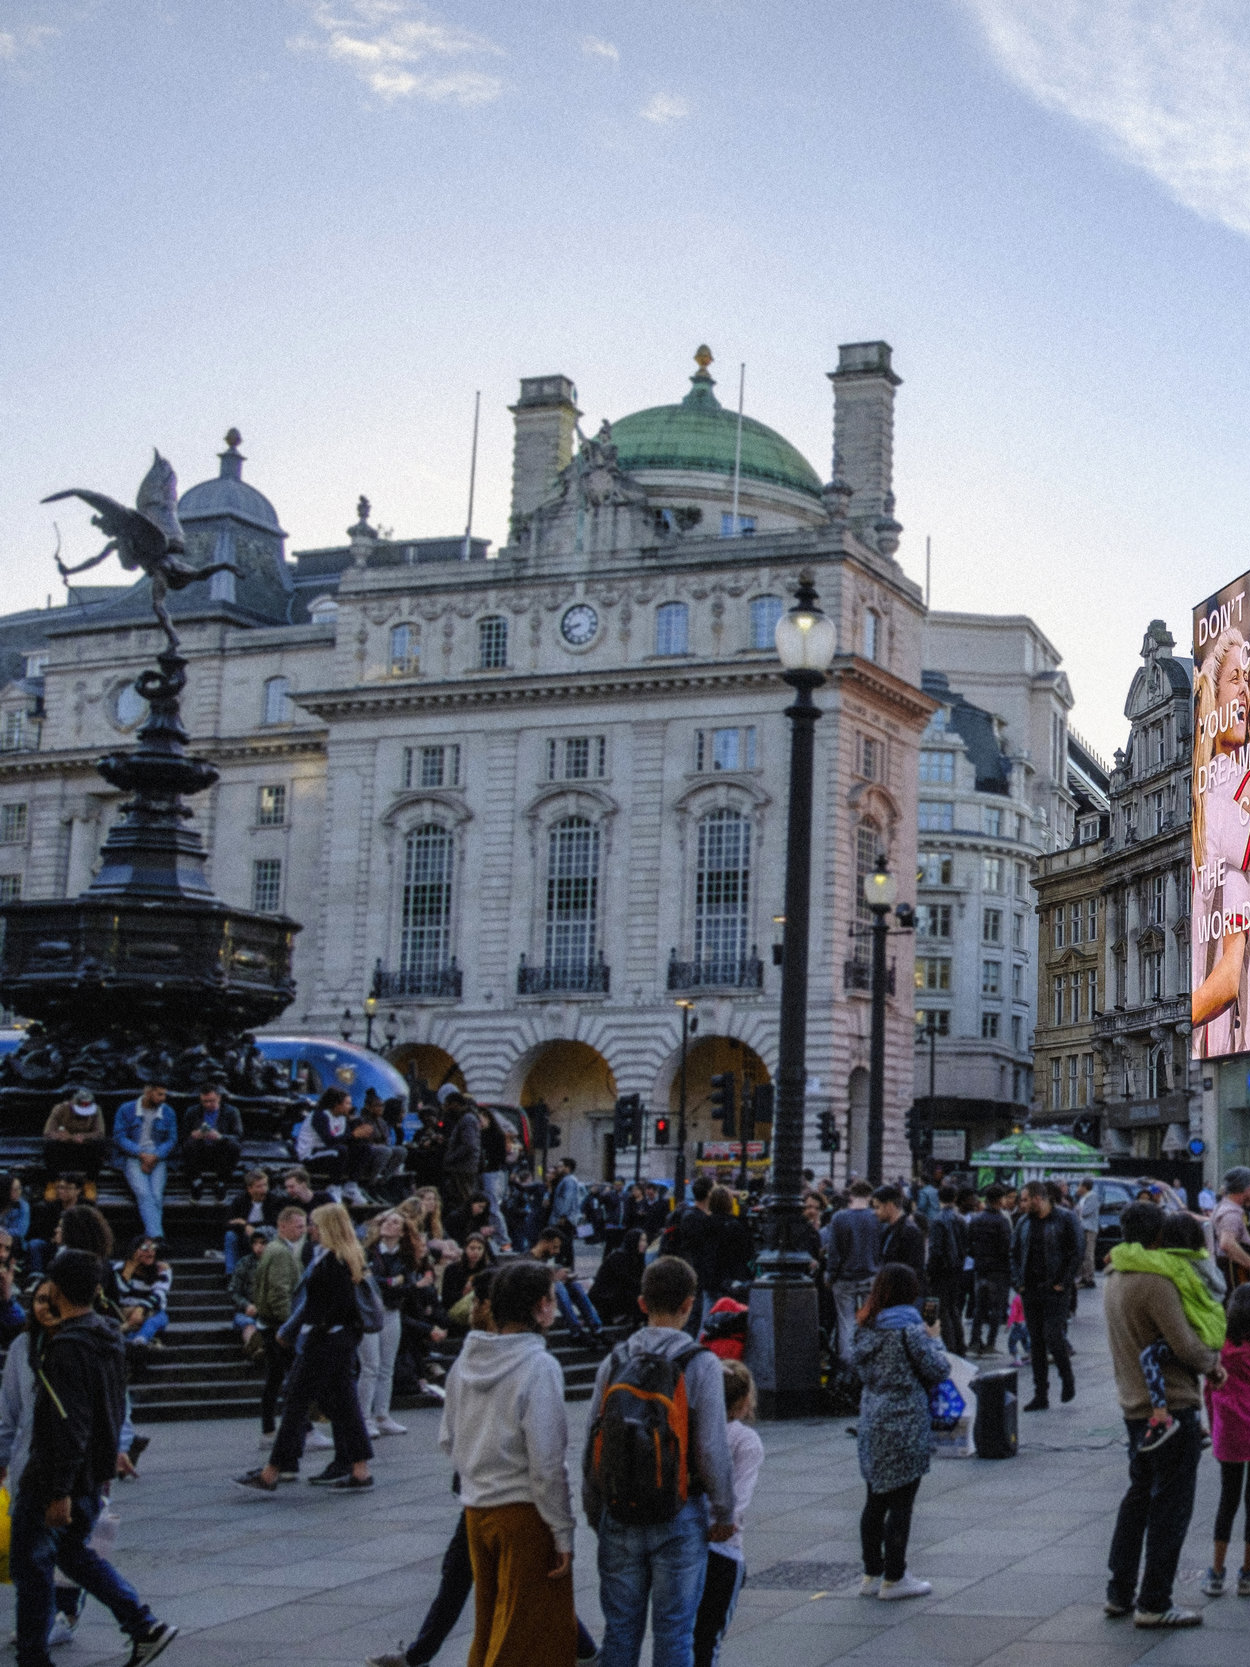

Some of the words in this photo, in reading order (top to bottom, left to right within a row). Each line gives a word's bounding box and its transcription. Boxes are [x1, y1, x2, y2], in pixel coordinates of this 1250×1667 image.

[1198, 591, 1246, 647] DON'T
[1199, 698, 1240, 744] YOUR
[1197, 857, 1227, 894] THE
